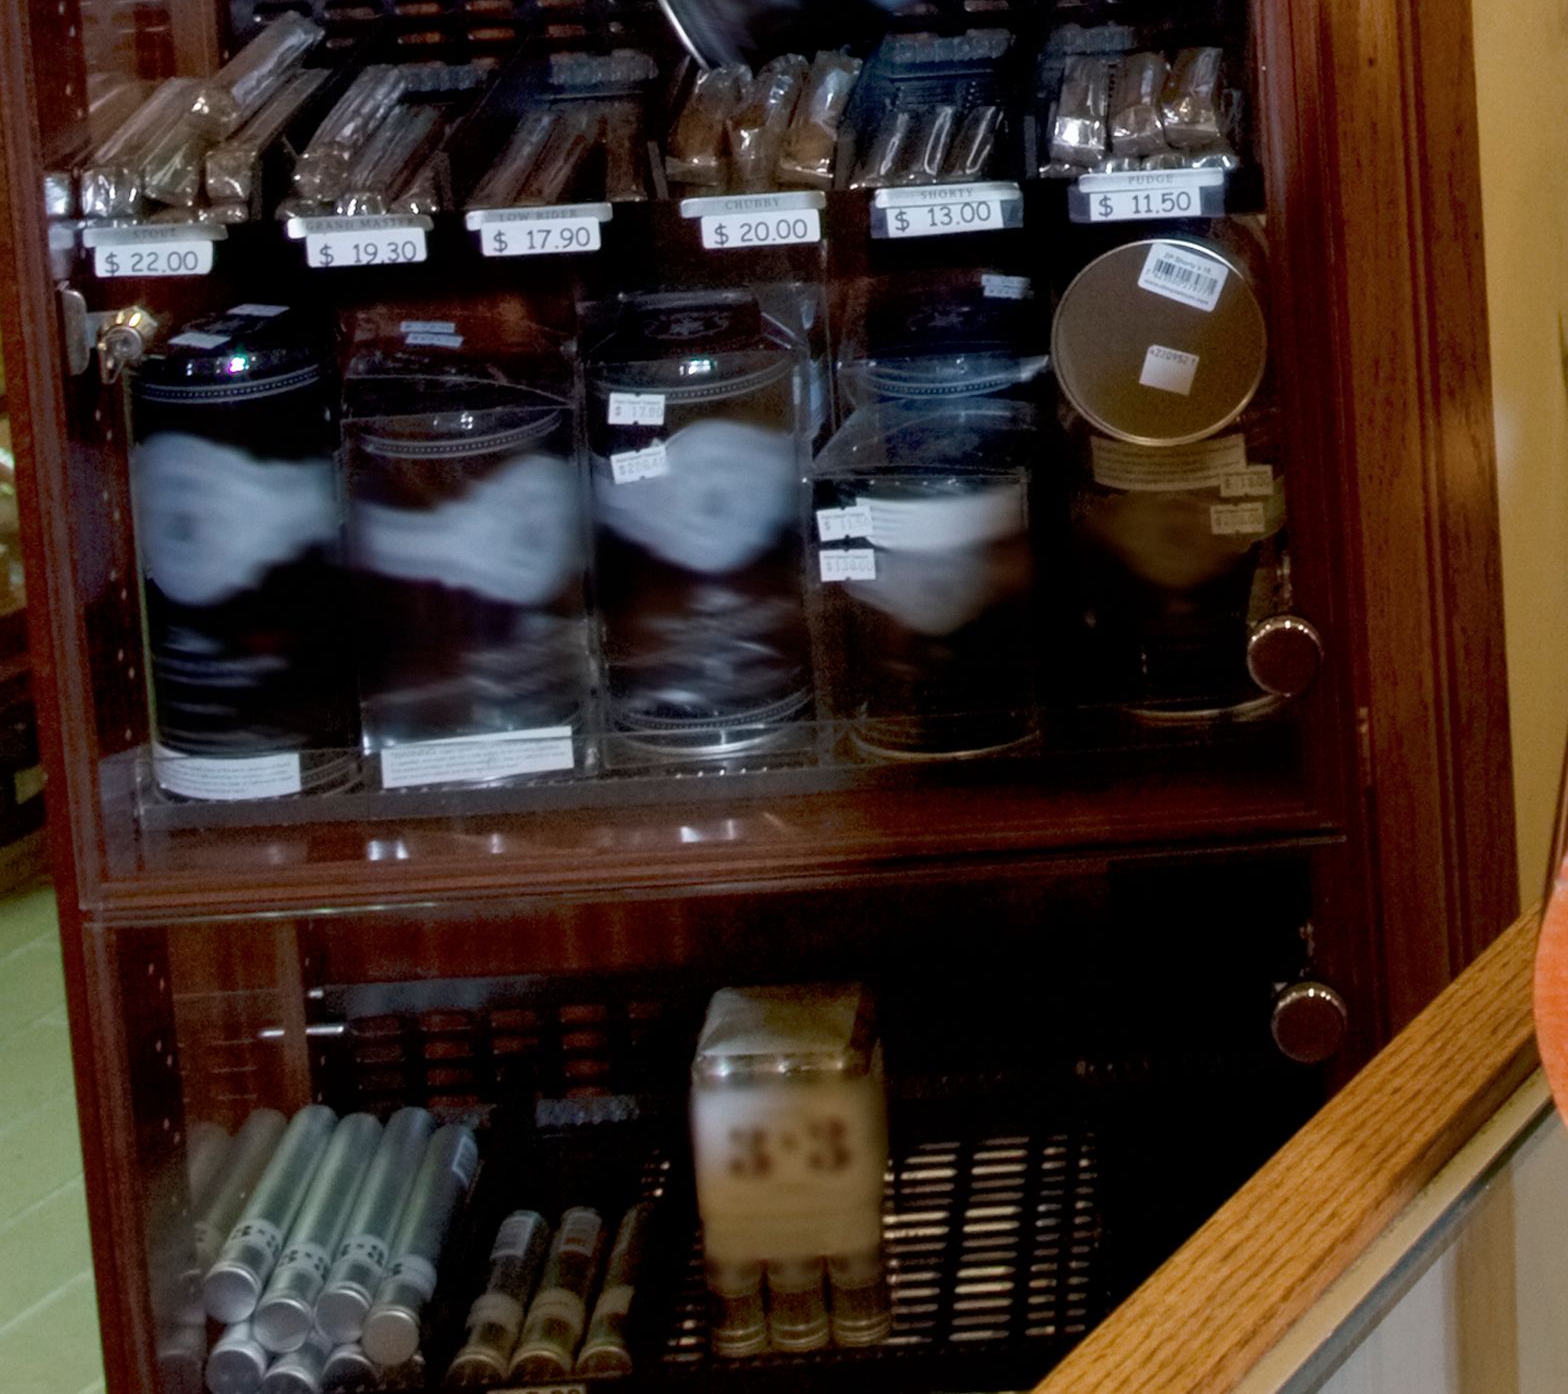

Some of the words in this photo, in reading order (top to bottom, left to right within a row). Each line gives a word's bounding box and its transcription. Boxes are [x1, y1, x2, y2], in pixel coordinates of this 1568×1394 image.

[724, 196, 781, 212] CHUBBY
[920, 187, 974, 200] SHORTY
[1098, 194, 1114, 218] $
[1131, 191, 1192, 215] 11.50
[894, 209, 911, 232] $
[927, 200, 991, 227] 13.00
[493, 229, 509, 253] $
[527, 226, 591, 251] 17.90
[713, 222, 730, 247] $
[740, 218, 808, 244] 20.00
[104, 250, 120, 276] $
[130, 250, 200, 274] 22.00
[319, 243, 335, 267] $
[352, 240, 417, 265] 19.30
